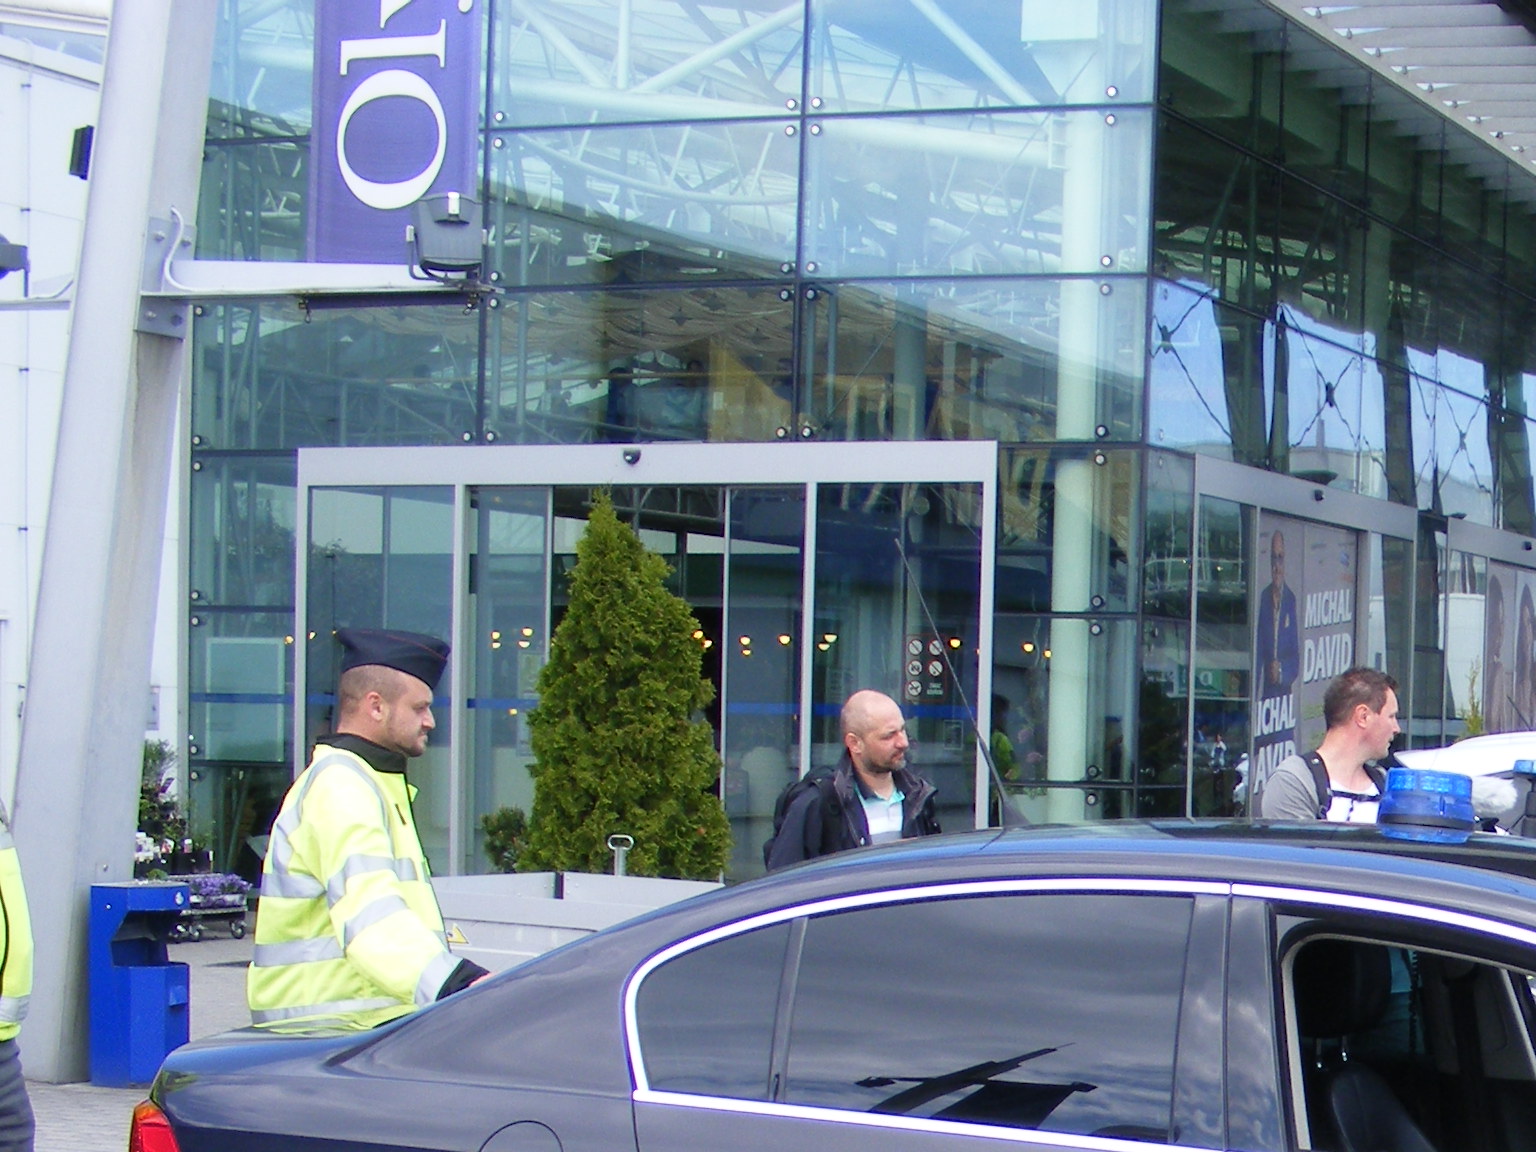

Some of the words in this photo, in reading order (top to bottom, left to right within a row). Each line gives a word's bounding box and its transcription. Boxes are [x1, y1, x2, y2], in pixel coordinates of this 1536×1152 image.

[1304, 588, 1353, 629] MICHAL
[1303, 632, 1353, 684] DAVID
[1254, 694, 1297, 737] ICHAL
